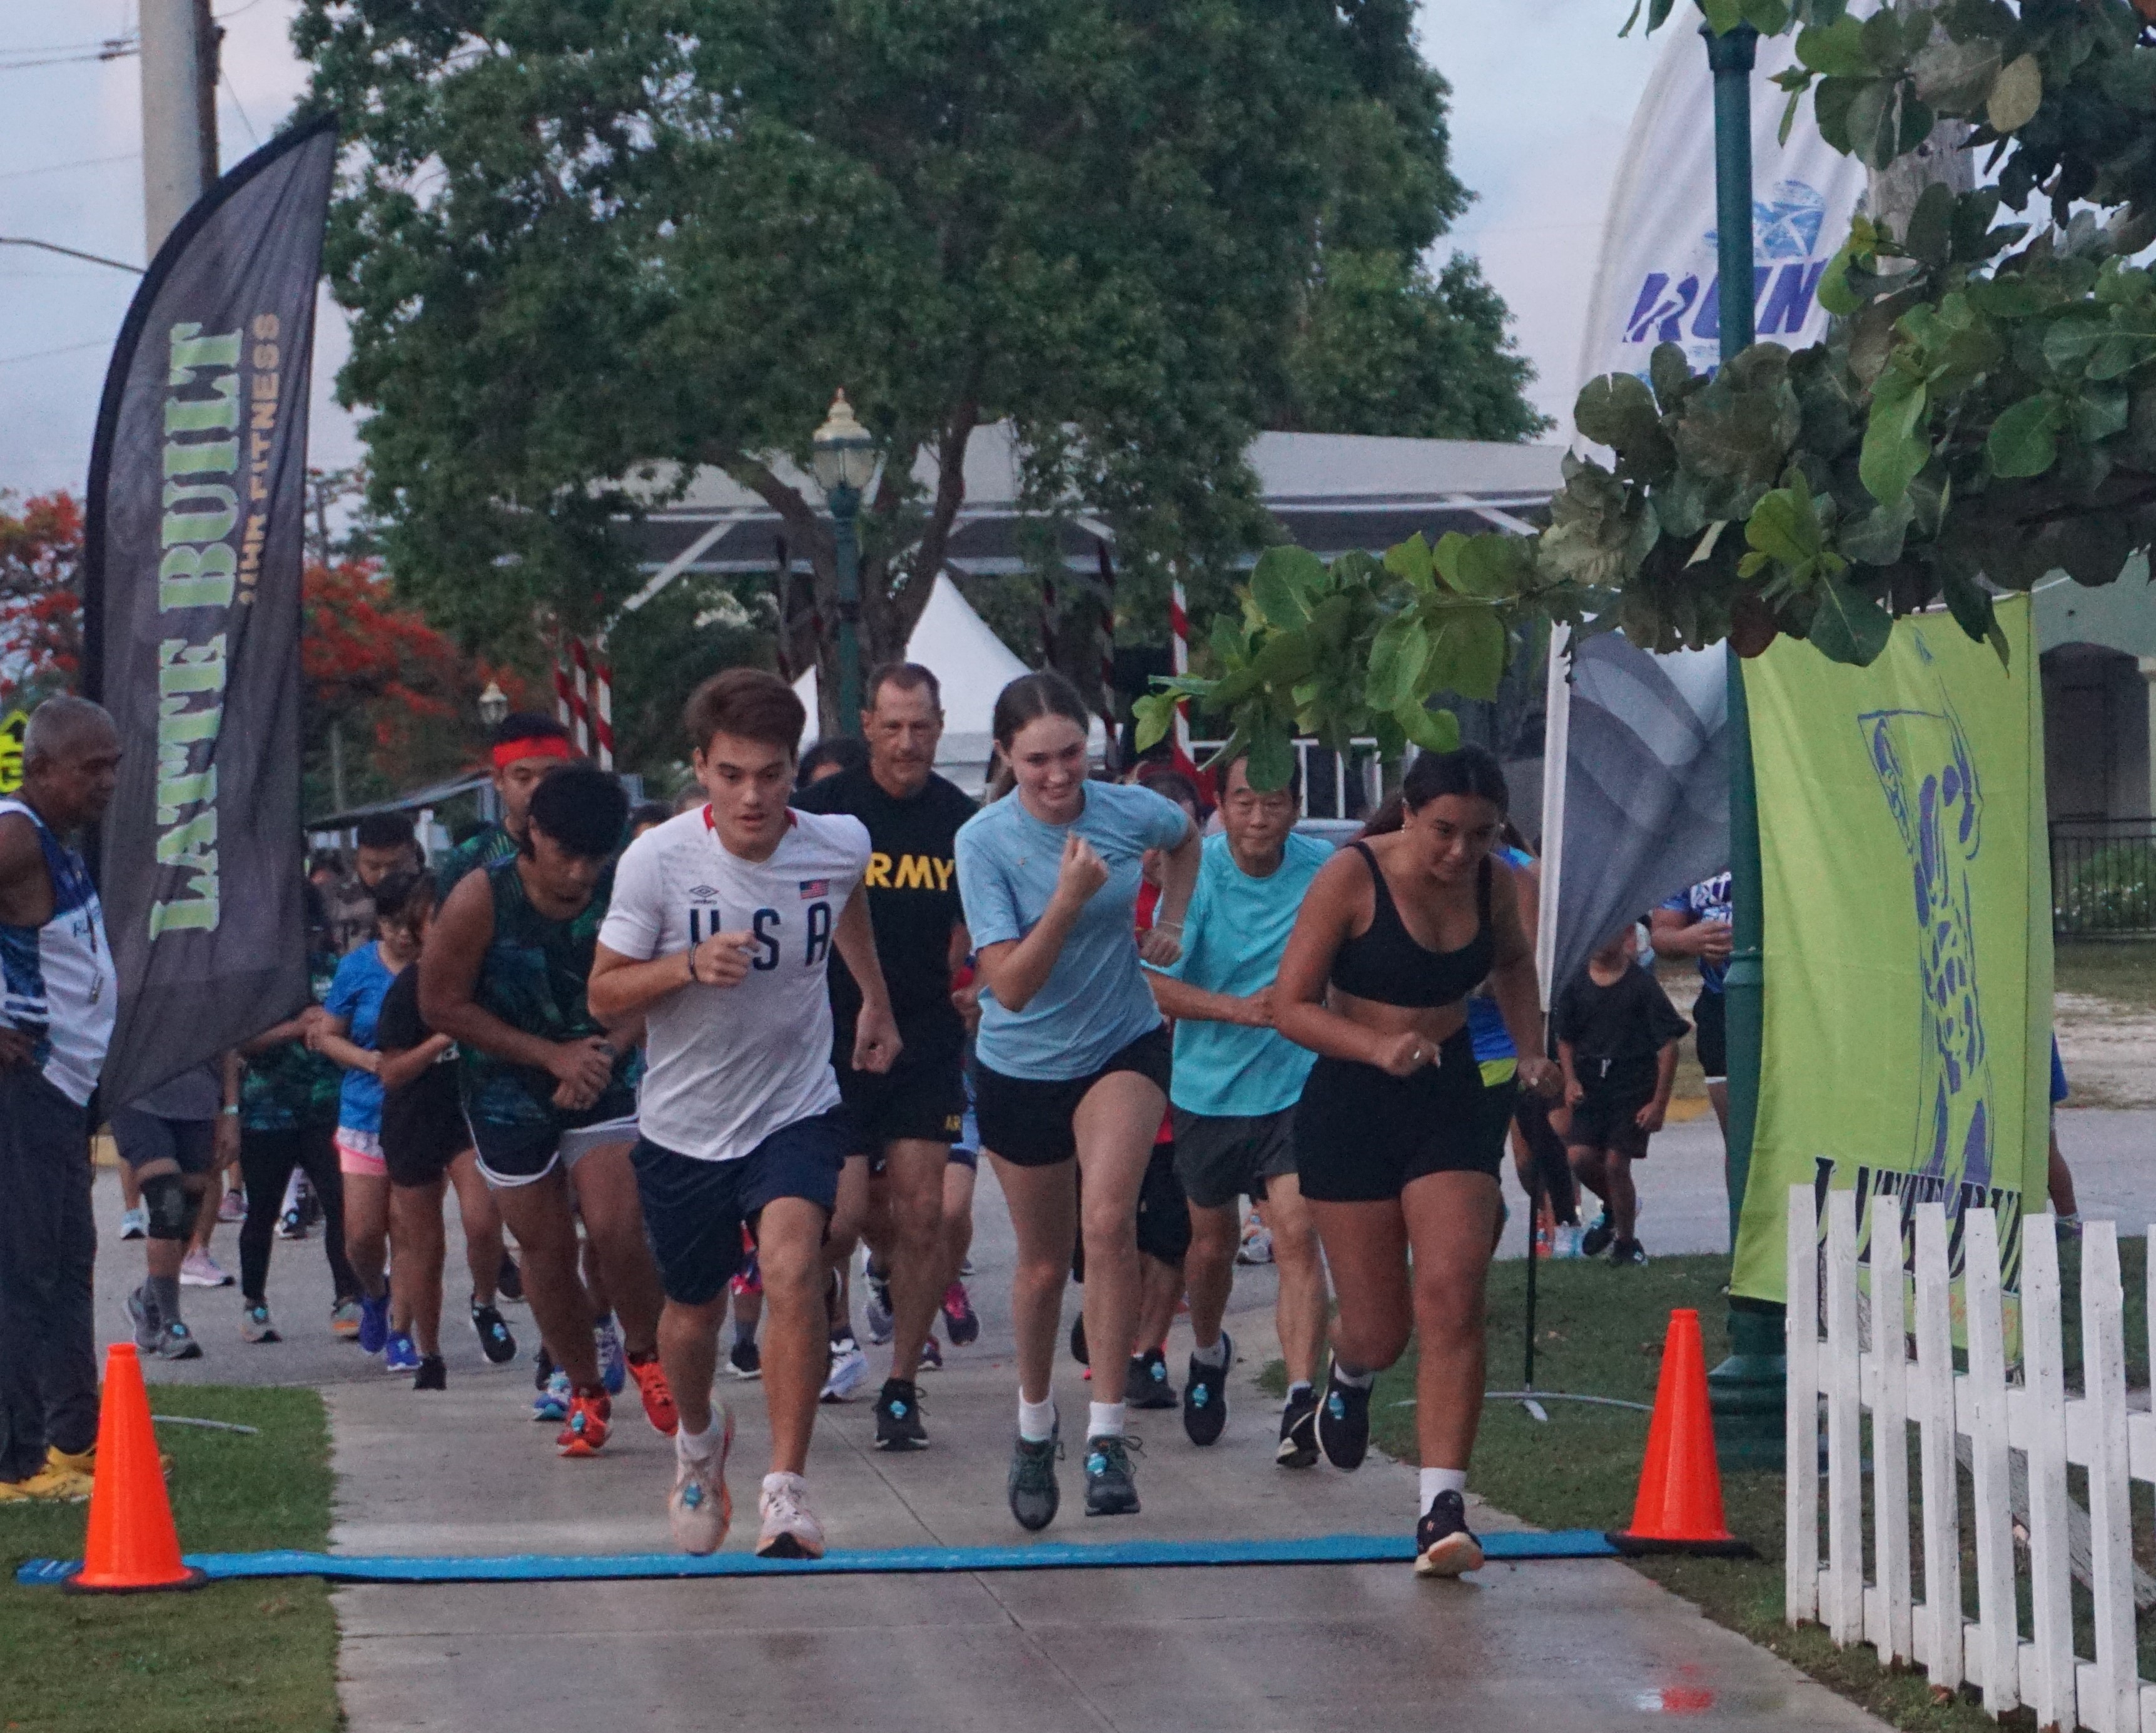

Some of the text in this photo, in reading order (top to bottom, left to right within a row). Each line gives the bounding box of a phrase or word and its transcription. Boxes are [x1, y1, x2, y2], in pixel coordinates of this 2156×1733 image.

[250, 313, 280, 501] FITNESS
[149, 322, 244, 942] LATTE BUILT
[864, 851, 955, 892] RMY
